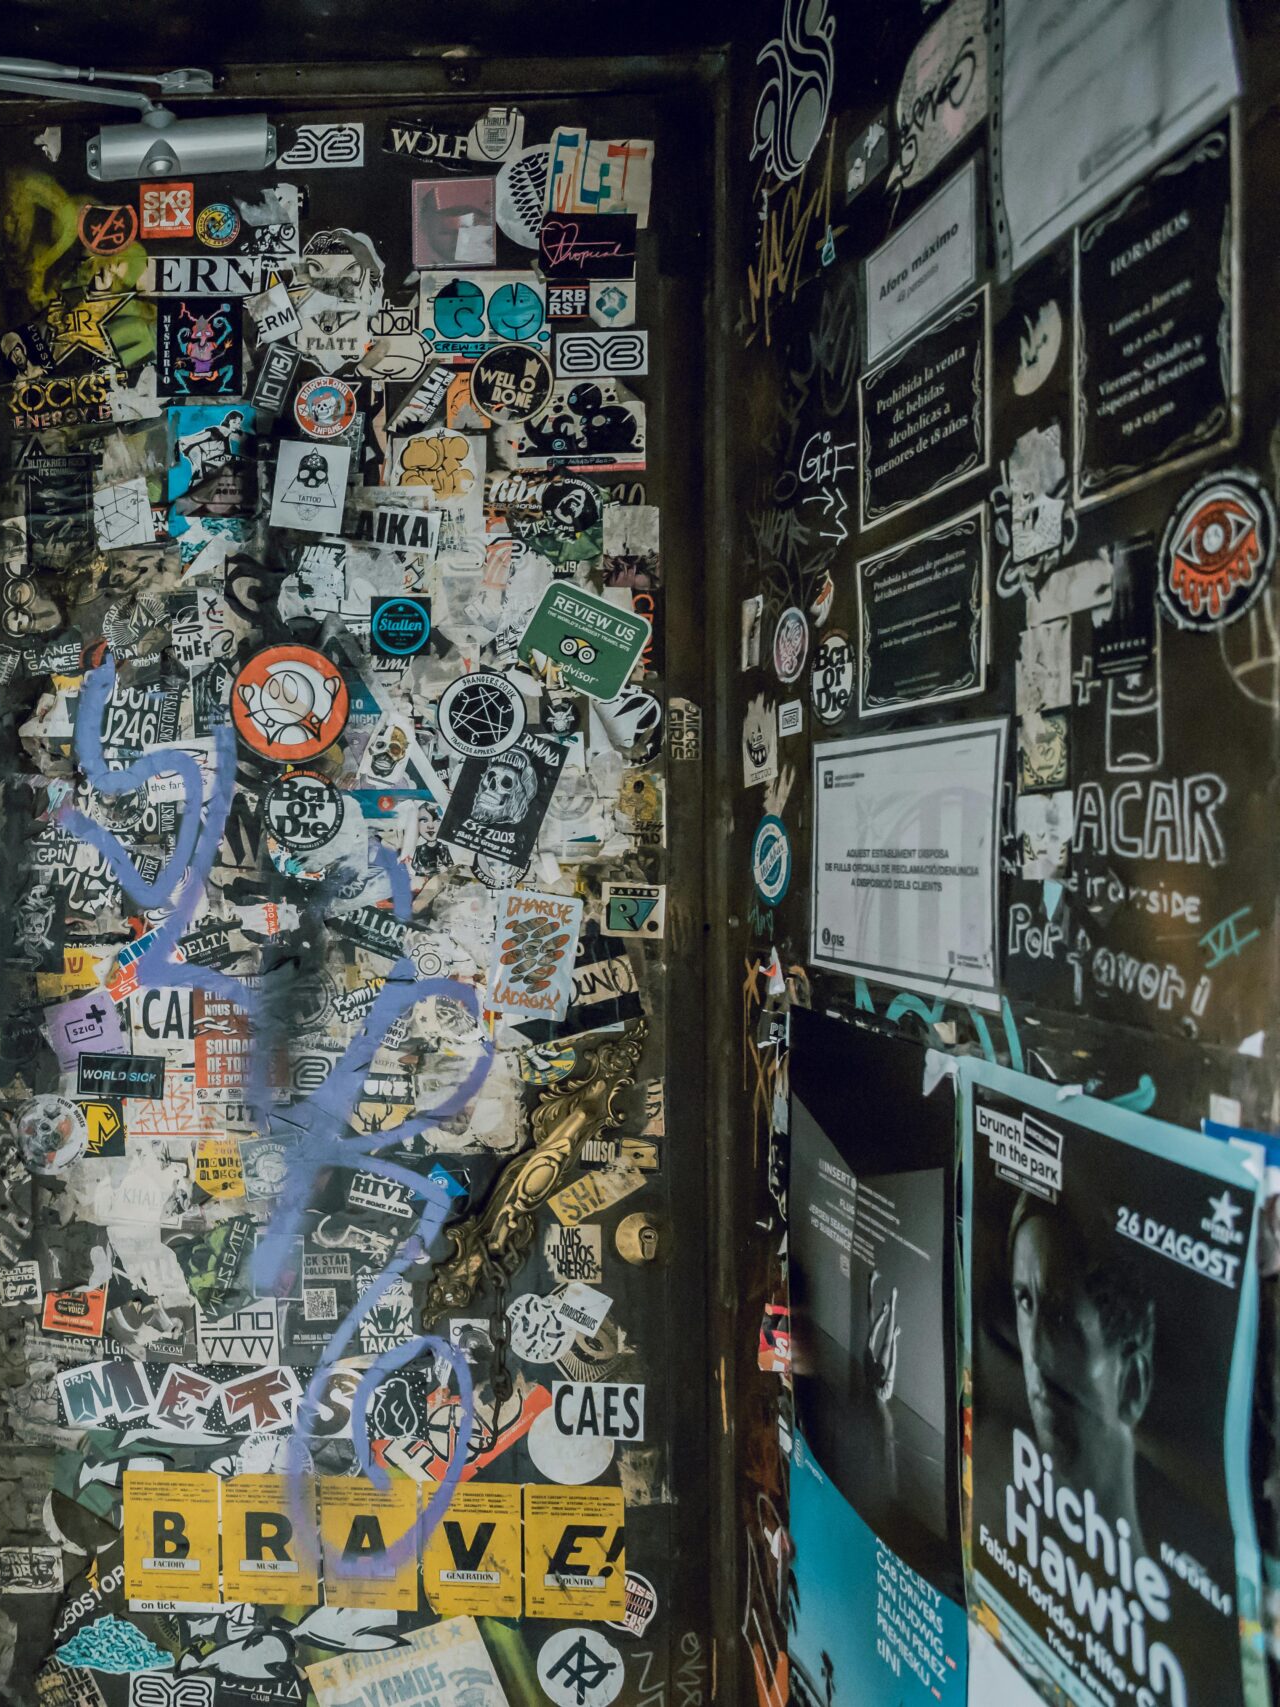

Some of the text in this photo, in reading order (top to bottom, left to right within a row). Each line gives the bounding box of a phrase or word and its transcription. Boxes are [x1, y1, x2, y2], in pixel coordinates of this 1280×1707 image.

[142, 190, 192, 210] SK8
[142, 208, 192, 228] DLX
[877, 267, 909, 301] Aforo
[910, 222, 959, 272] máximo
[549, 303, 587, 315] RST
[550, 289, 587, 302] ZRB
[875, 345, 966, 415] Prohibida la venta
[892, 381, 945, 425] de bebidas
[886, 406, 942, 450] alcoholicas
[873, 413, 970, 480] menores de 18 años
[552, 595, 636, 643] REVIEW US
[578, 622, 601, 639] LARGEST
[280, 780, 334, 803] Bcn
[275, 815, 331, 839] Die
[286, 801, 326, 819] or
[485, 829, 516, 844] 2008
[846, 849, 871, 858] AQUEST
[82, 1069, 127, 1083] WORLD
[978, 1109, 1021, 1144] brunch
[995, 1139, 1007, 1156] in
[1008, 1143, 1029, 1168] the
[1029, 1157, 1059, 1185] park
[348, 1195, 410, 1217] GET SOME FAME
[559, 1227, 582, 1247] MIS
[1115, 1205, 1140, 1237] 26
[1143, 1219, 1240, 1284] D'AGOST
[553, 1383, 641, 1439] CAES
[152, 1510, 191, 1560] B
[245, 1511, 295, 1561] R
[341, 1514, 388, 1562] A
[442, 1520, 497, 1571] V
[1011, 1427, 1171, 1623] Richie
[153, 1559, 186, 1569] FACTORY
[446, 1571, 494, 1582] GENERATION
[876, 1551, 944, 1635] CAB DRIVERS
[979, 1523, 1076, 1641] Fabio Florido
[1005, 1483, 1188, 1707] Hawtin
[140, 1600, 176, 1610] on tick
[877, 1569, 944, 1657] ION LUDWIG
[877, 1591, 947, 1684] JULIAN PEREZ
